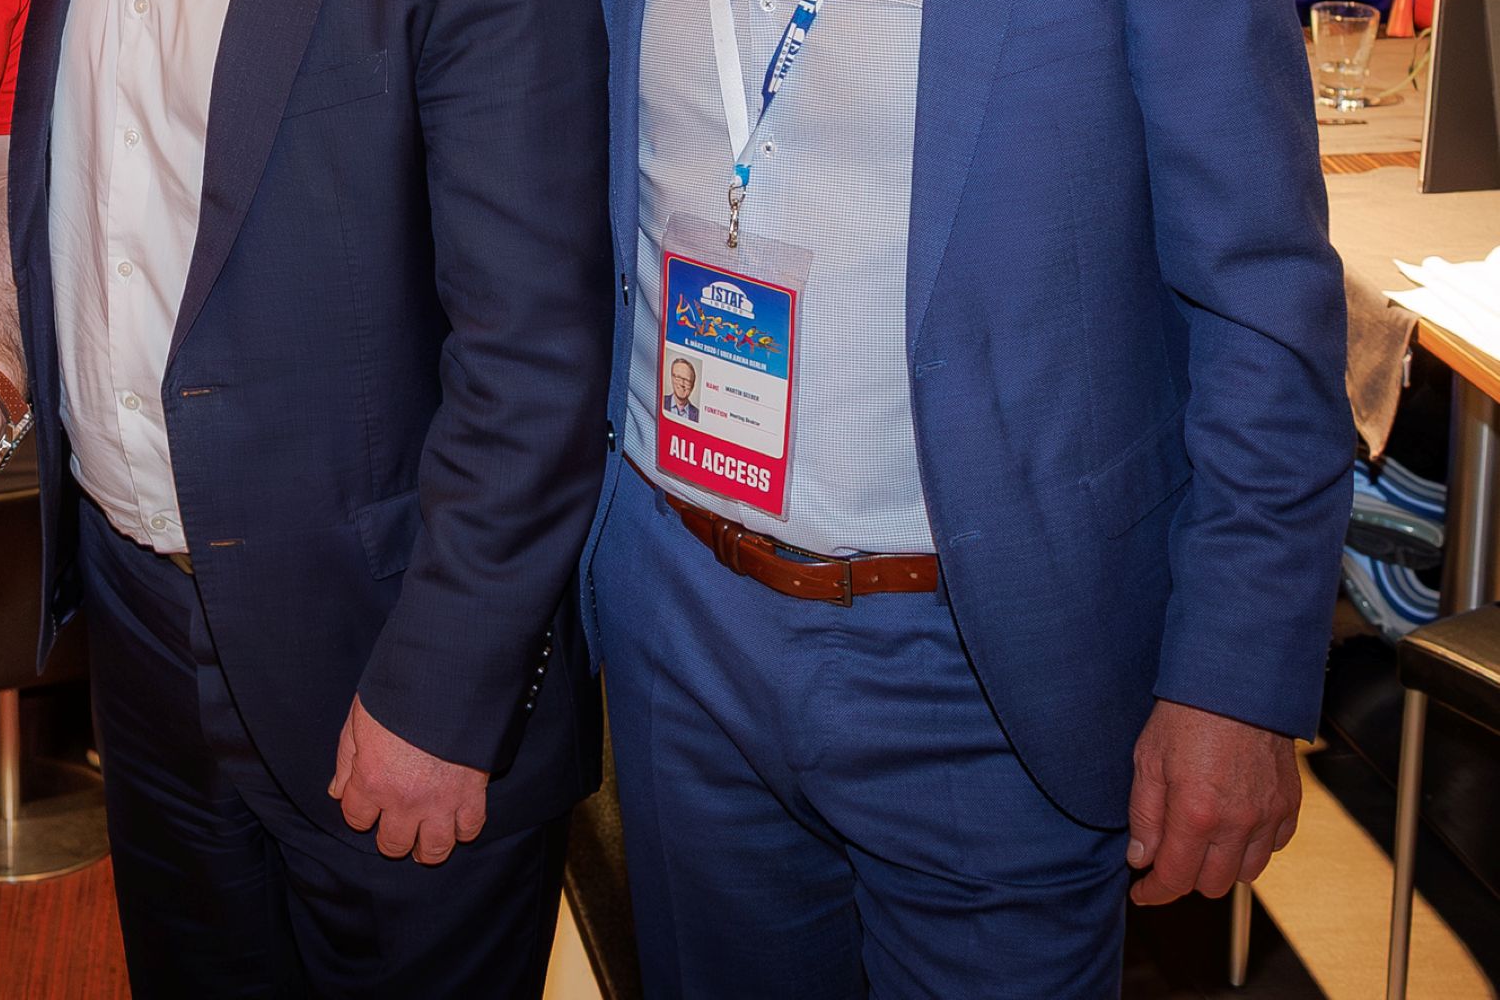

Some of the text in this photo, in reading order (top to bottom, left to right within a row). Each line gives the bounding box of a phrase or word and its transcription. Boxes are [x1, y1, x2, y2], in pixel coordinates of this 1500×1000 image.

[711, 285, 744, 309] ISTAF
[706, 382, 719, 391] NAME
[704, 405, 728, 418] FUNKTION
[669, 435, 771, 492] ALL ACCESS
